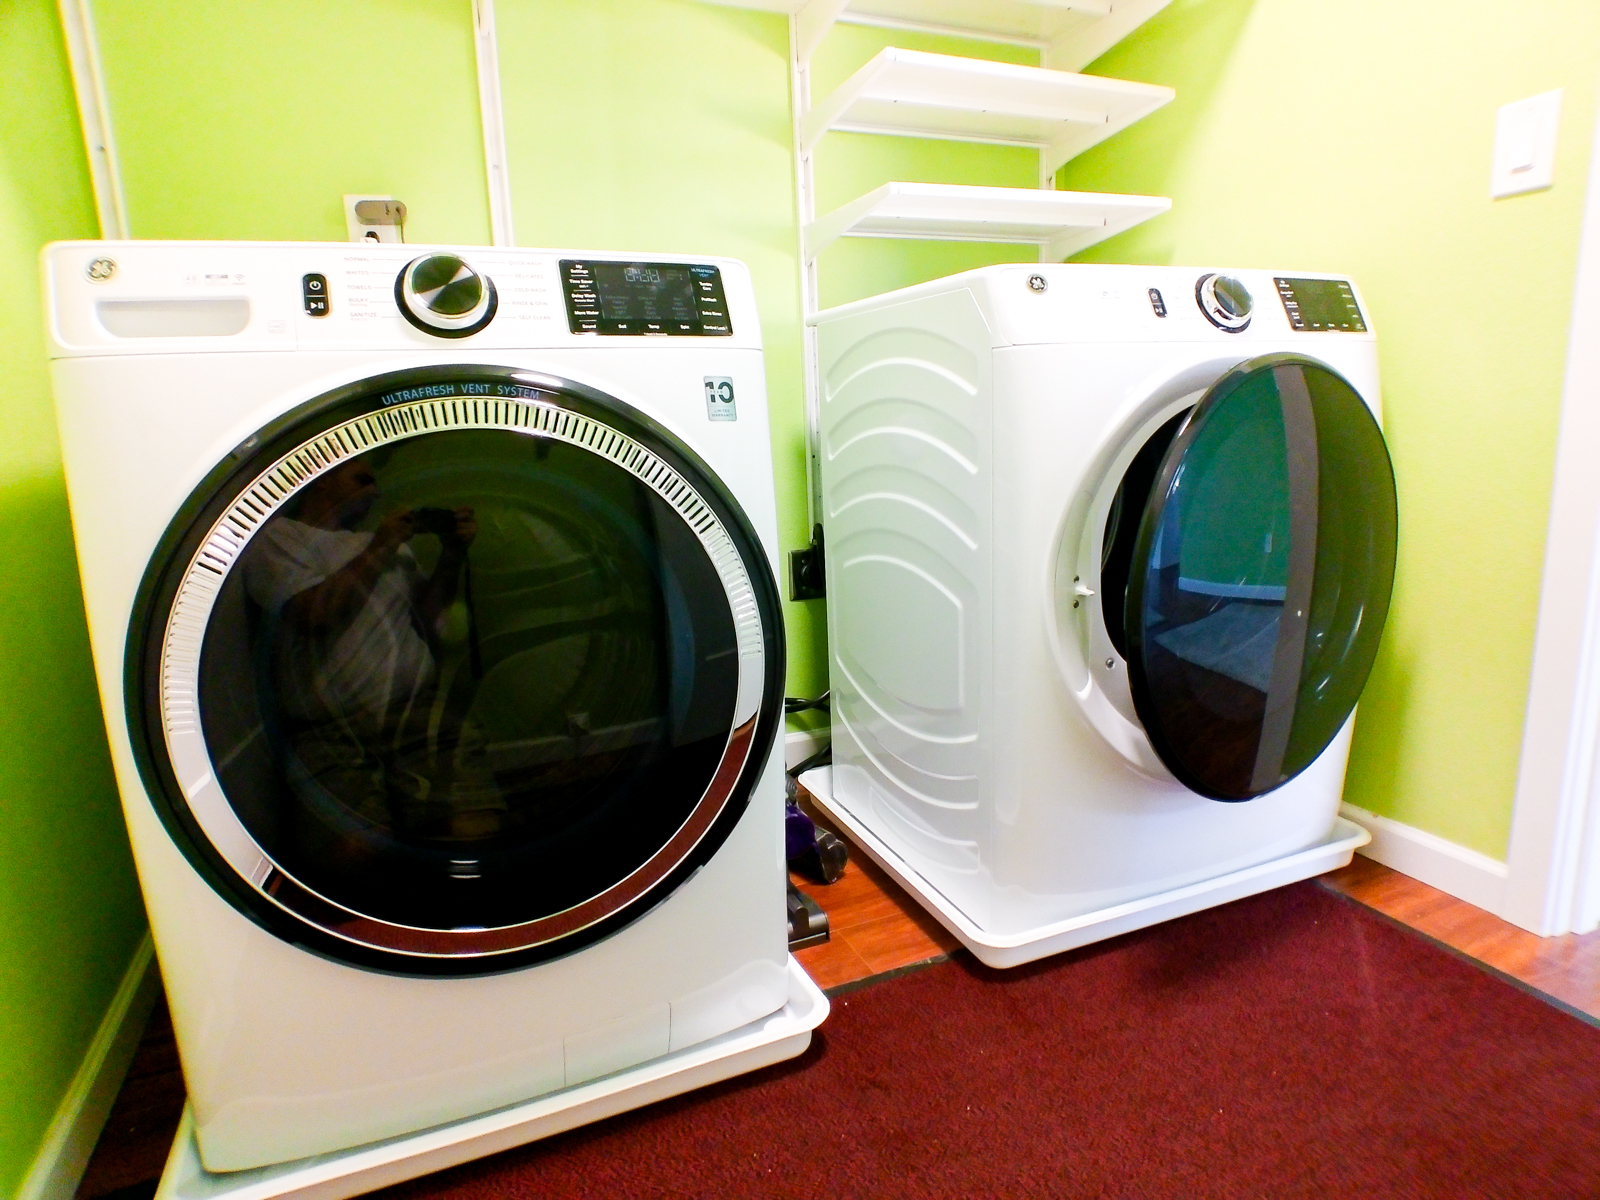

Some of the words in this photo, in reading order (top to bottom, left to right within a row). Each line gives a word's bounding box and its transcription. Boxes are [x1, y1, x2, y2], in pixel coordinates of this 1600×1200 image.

[382, 384, 454, 406] ULTRAFRESH
[461, 384, 490, 394] VENT
[498, 385, 540, 400] SYSTEM
[705, 381, 734, 403] 10
